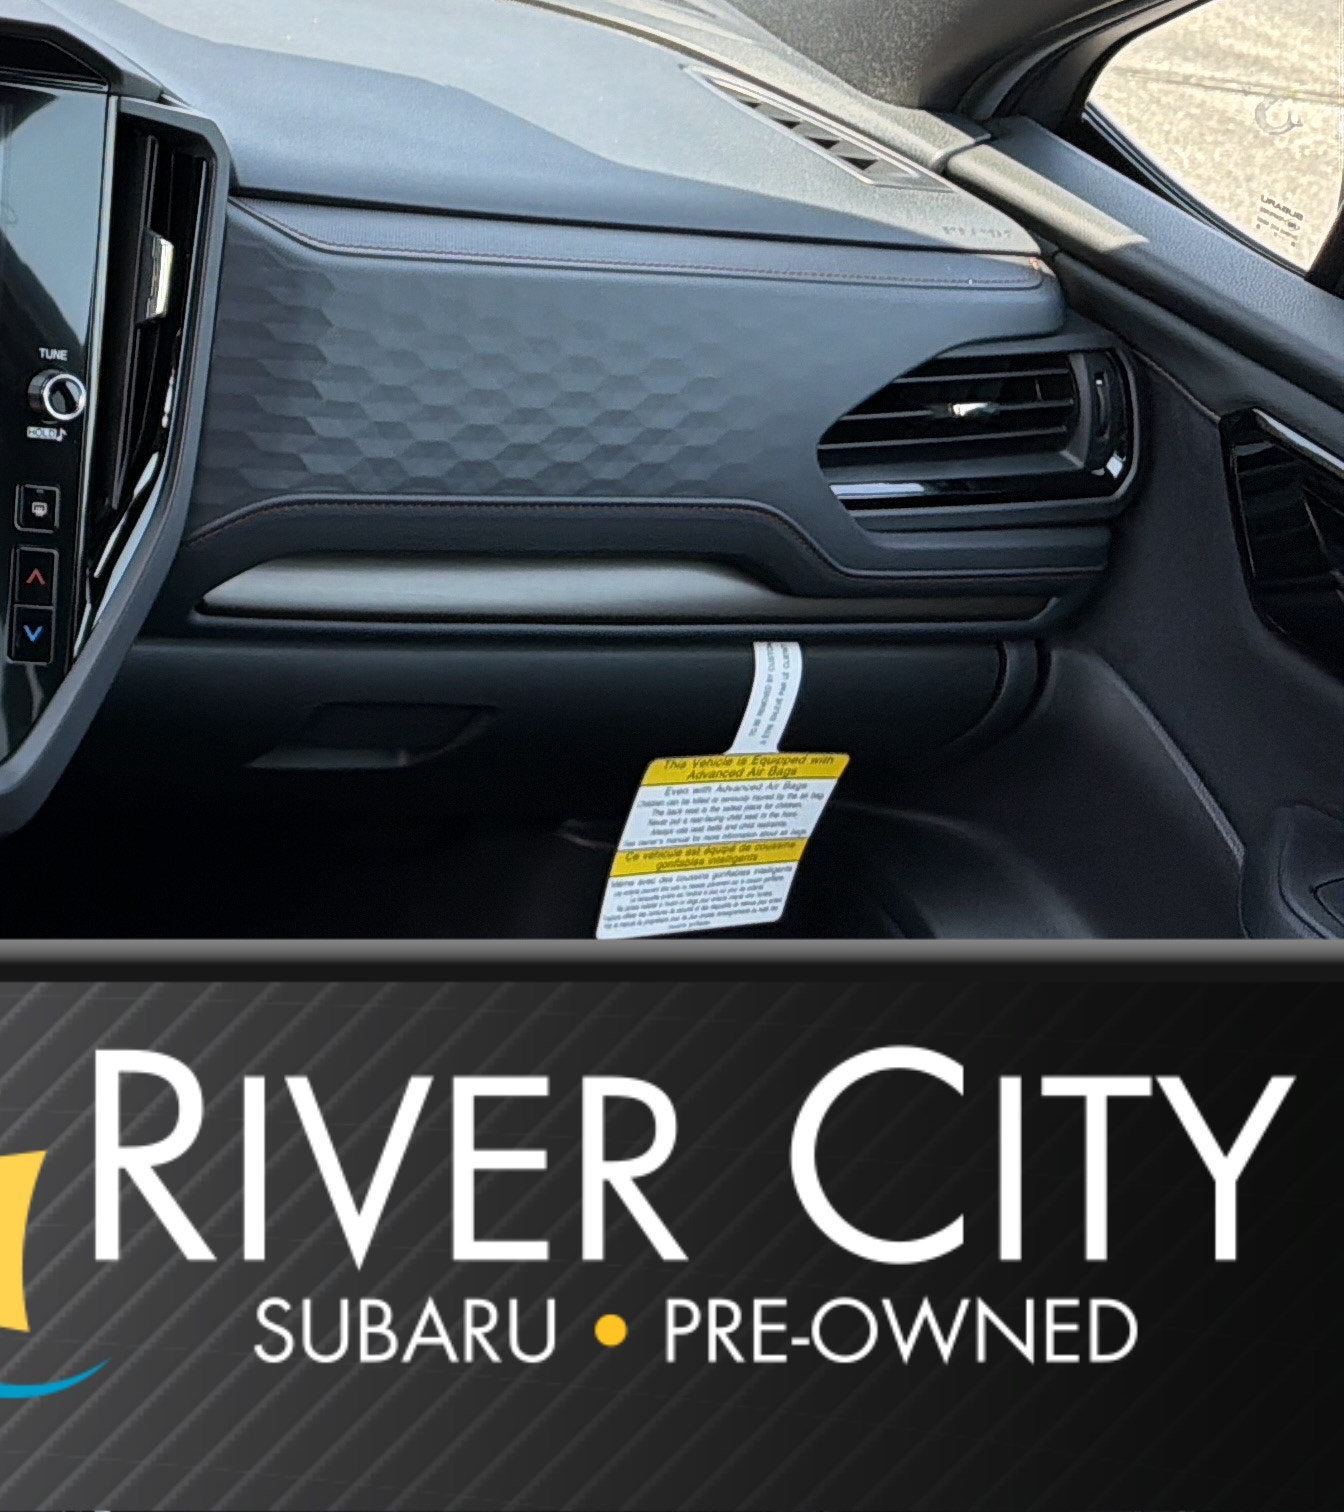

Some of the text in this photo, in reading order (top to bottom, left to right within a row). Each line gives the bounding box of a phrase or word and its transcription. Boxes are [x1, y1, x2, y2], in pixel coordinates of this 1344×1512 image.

[39, 347, 68, 361] TUNE
[693, 758, 732, 769] Vehicle
[751, 755, 806, 768] Equipped
[687, 766, 797, 780] Advanced Air Bags
